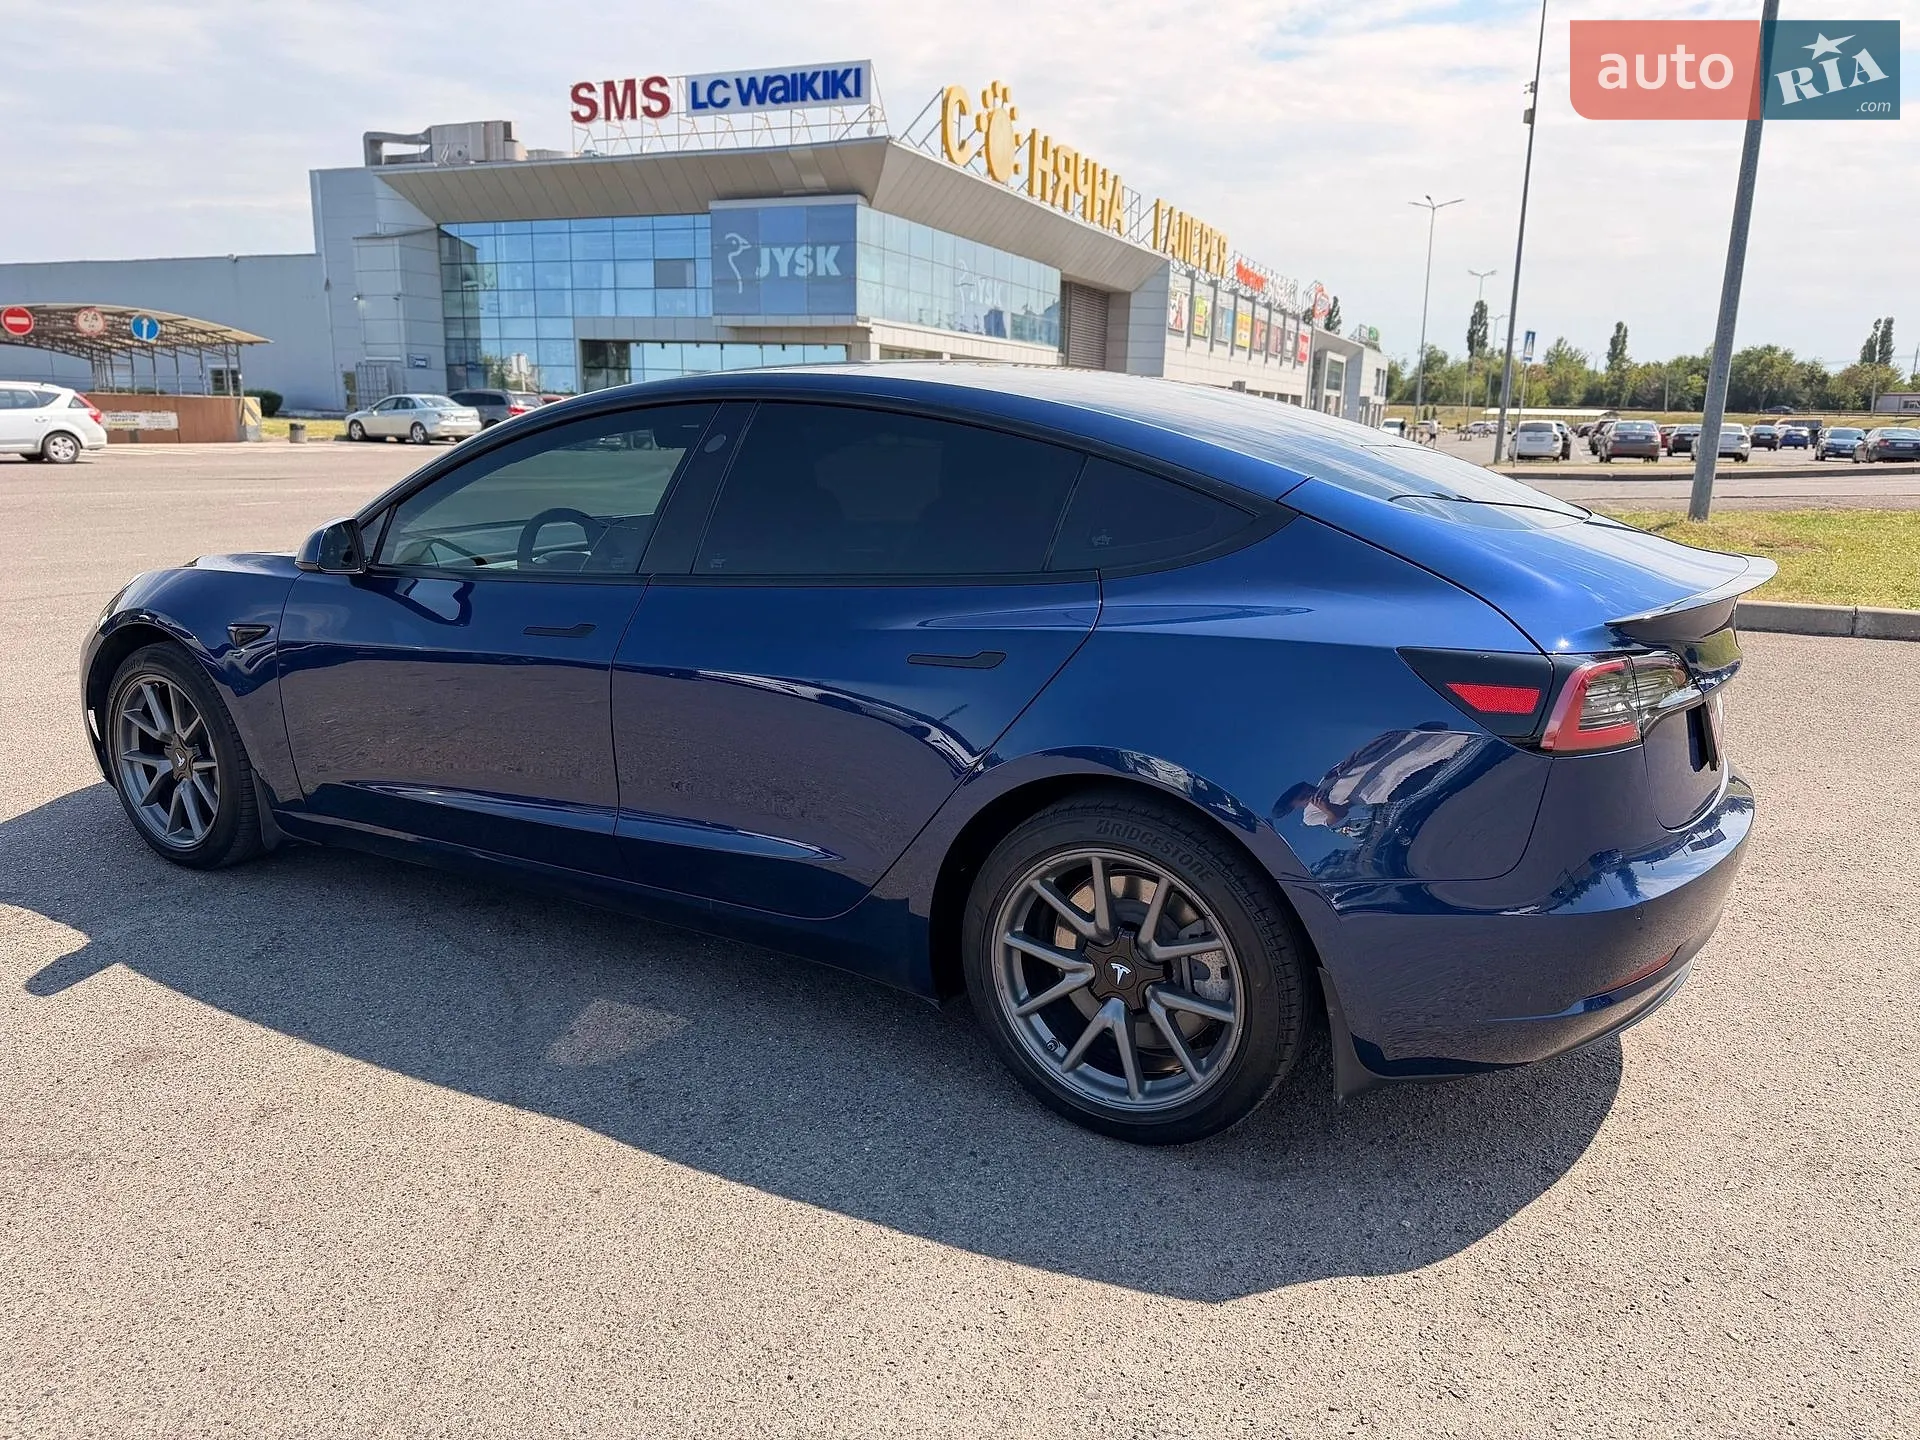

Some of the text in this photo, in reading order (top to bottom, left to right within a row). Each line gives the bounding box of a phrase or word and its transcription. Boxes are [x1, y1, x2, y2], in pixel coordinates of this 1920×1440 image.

[570, 76, 671, 123] SMS
[691, 79, 731, 110] LC
[755, 245, 841, 278] JYSK
[1152, 198, 1229, 279] ГАЛЕРЕЯ
[1096, 819, 1215, 882] BRIDGESTONE
